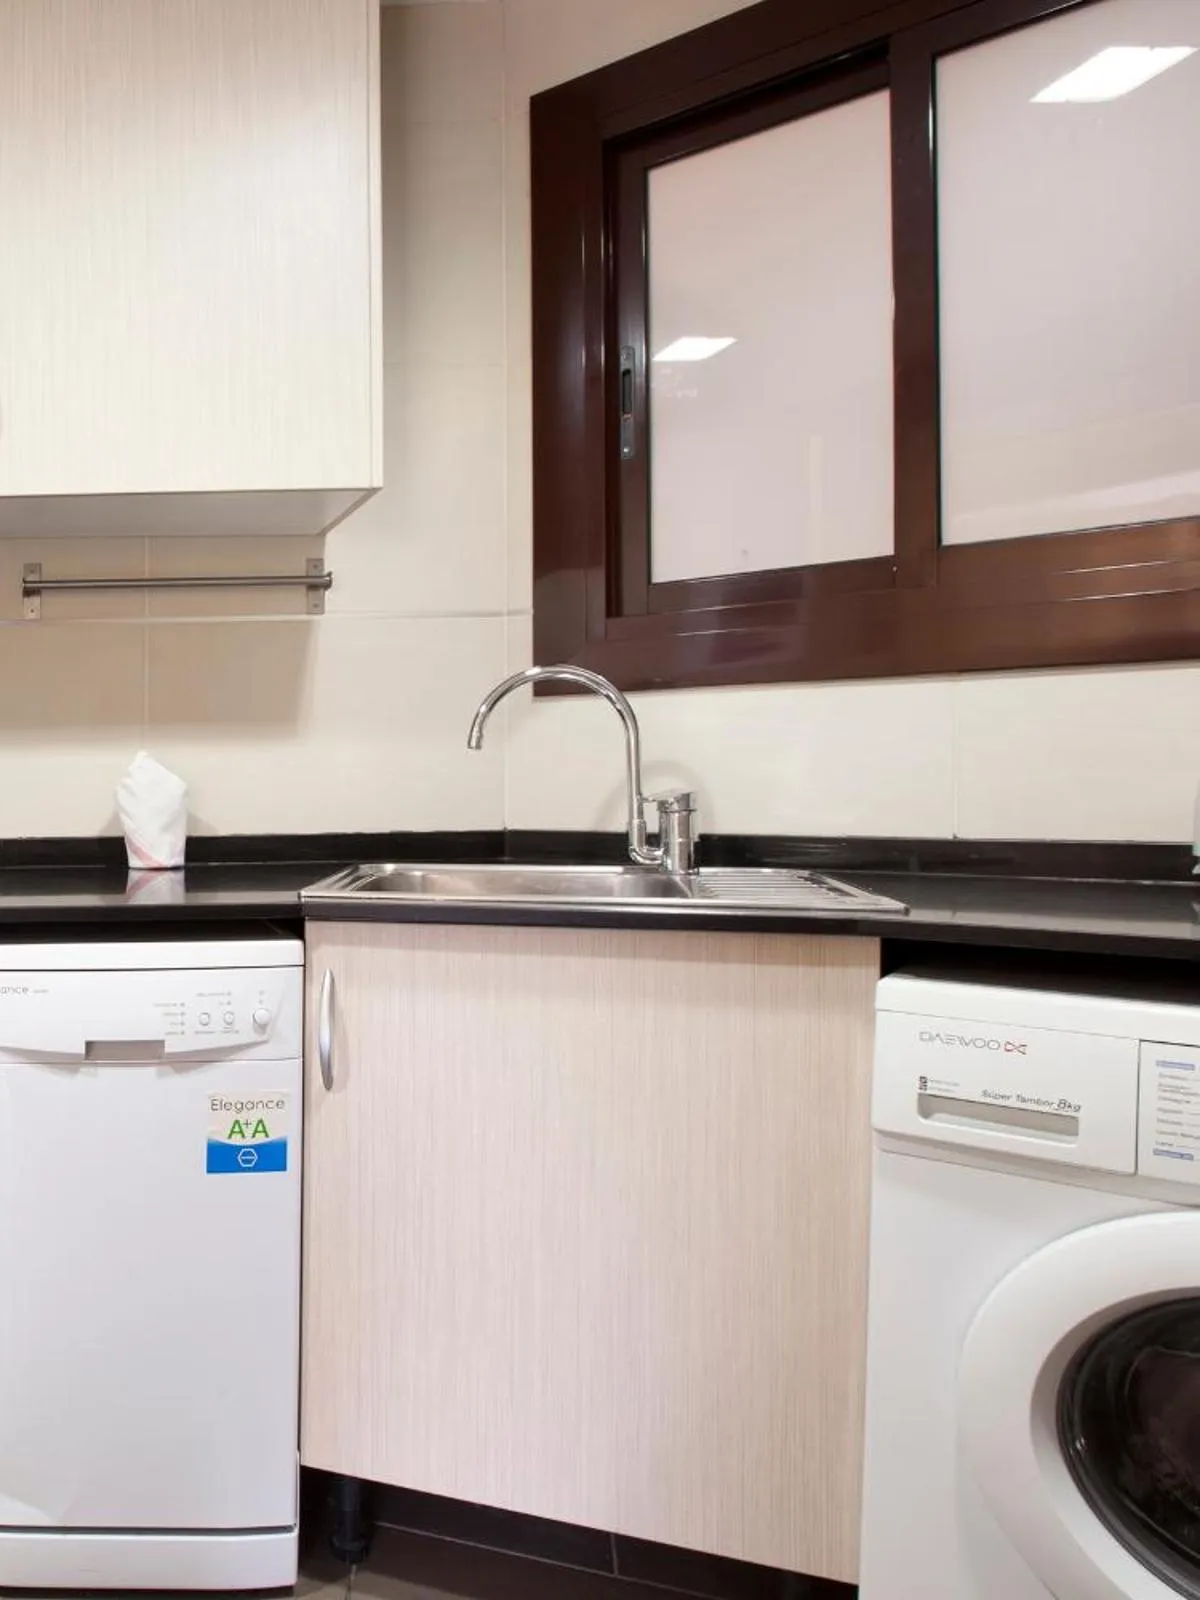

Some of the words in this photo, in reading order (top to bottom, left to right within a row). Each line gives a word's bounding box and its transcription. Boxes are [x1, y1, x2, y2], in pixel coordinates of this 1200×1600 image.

[919, 1031, 1001, 1051] DAEWOO
[981, 1089, 1013, 1101] Super
[210, 1099, 285, 1114] Elegance
